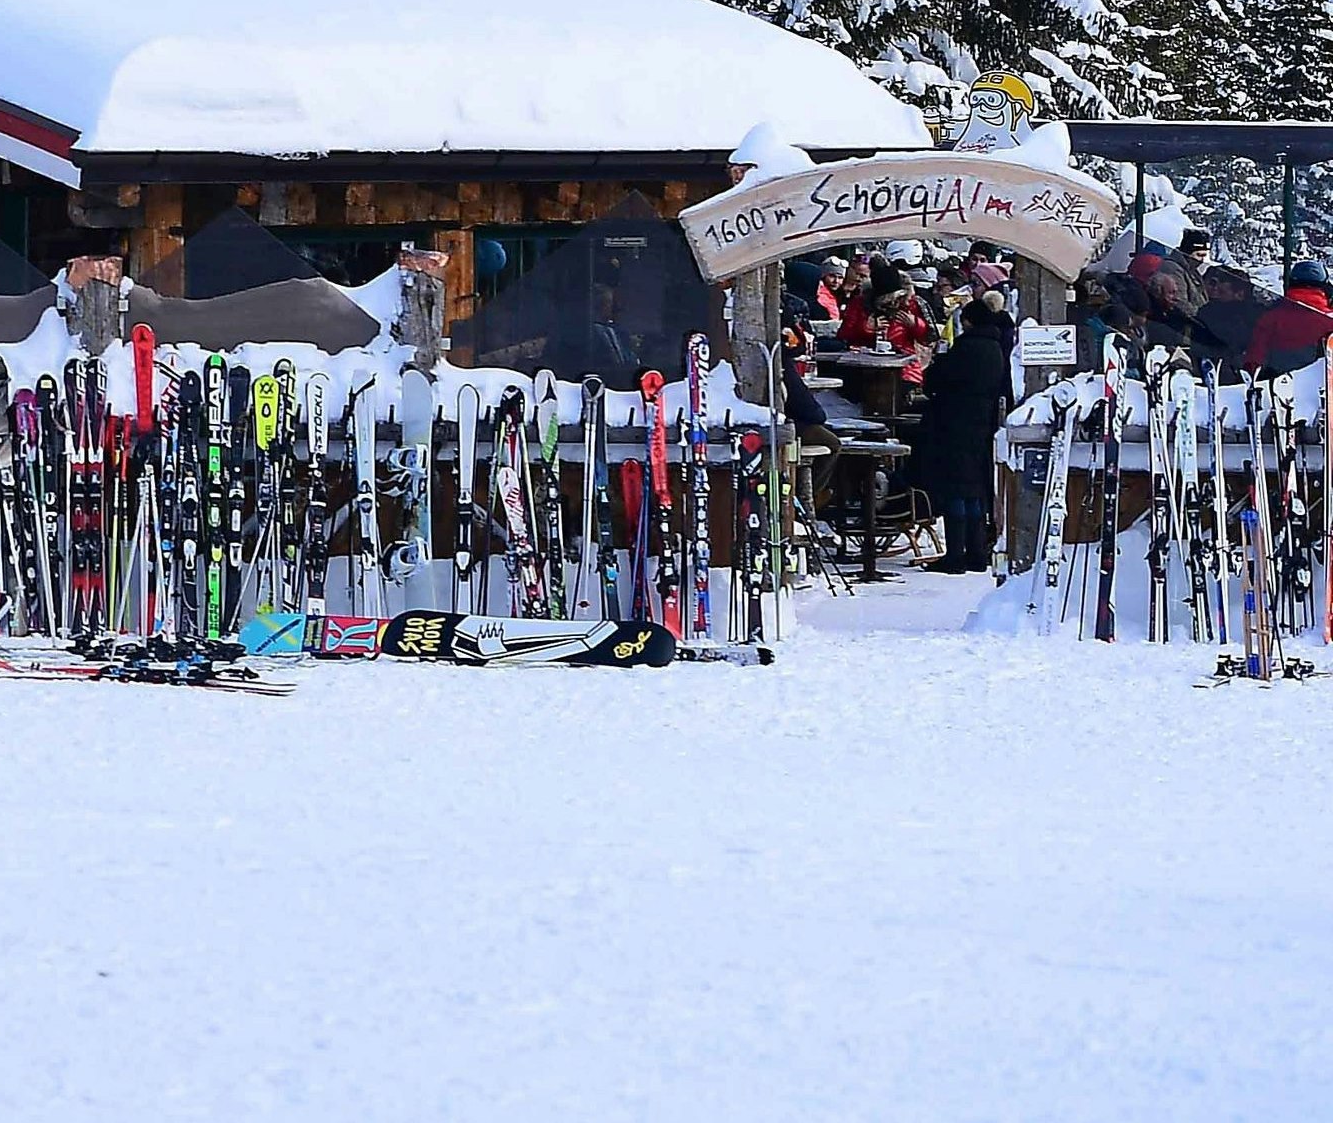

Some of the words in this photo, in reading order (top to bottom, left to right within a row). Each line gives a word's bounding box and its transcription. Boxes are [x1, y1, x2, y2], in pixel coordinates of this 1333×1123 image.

[704, 207, 767, 250] 1600
[775, 207, 796, 227] m
[208, 367, 222, 445] HEAD
